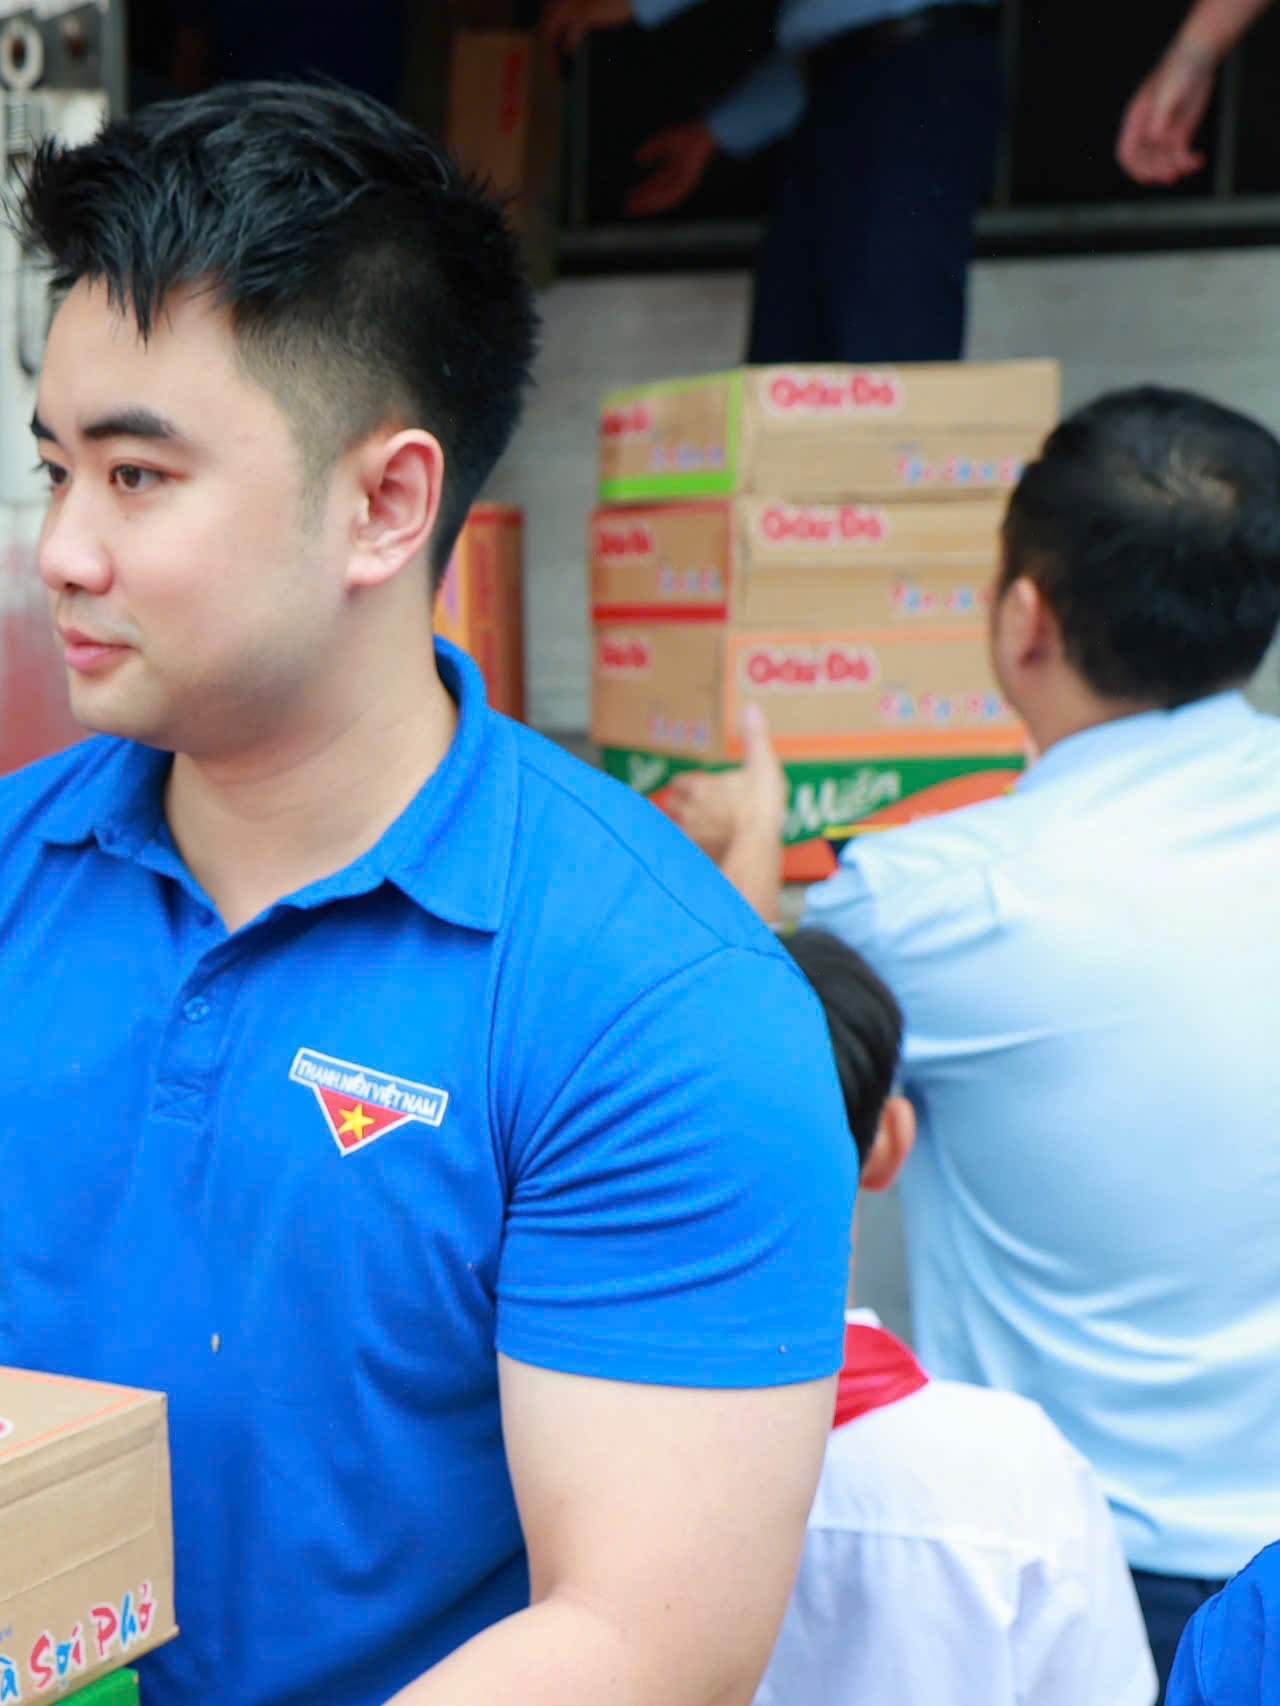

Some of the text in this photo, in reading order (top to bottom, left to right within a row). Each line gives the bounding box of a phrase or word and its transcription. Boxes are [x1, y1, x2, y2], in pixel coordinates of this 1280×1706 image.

[298, 1060, 340, 1086] THANH
[371, 1083, 402, 1107] VIỆT
[404, 1093, 438, 1117] NAM
[91, 1583, 153, 1657] Phở
